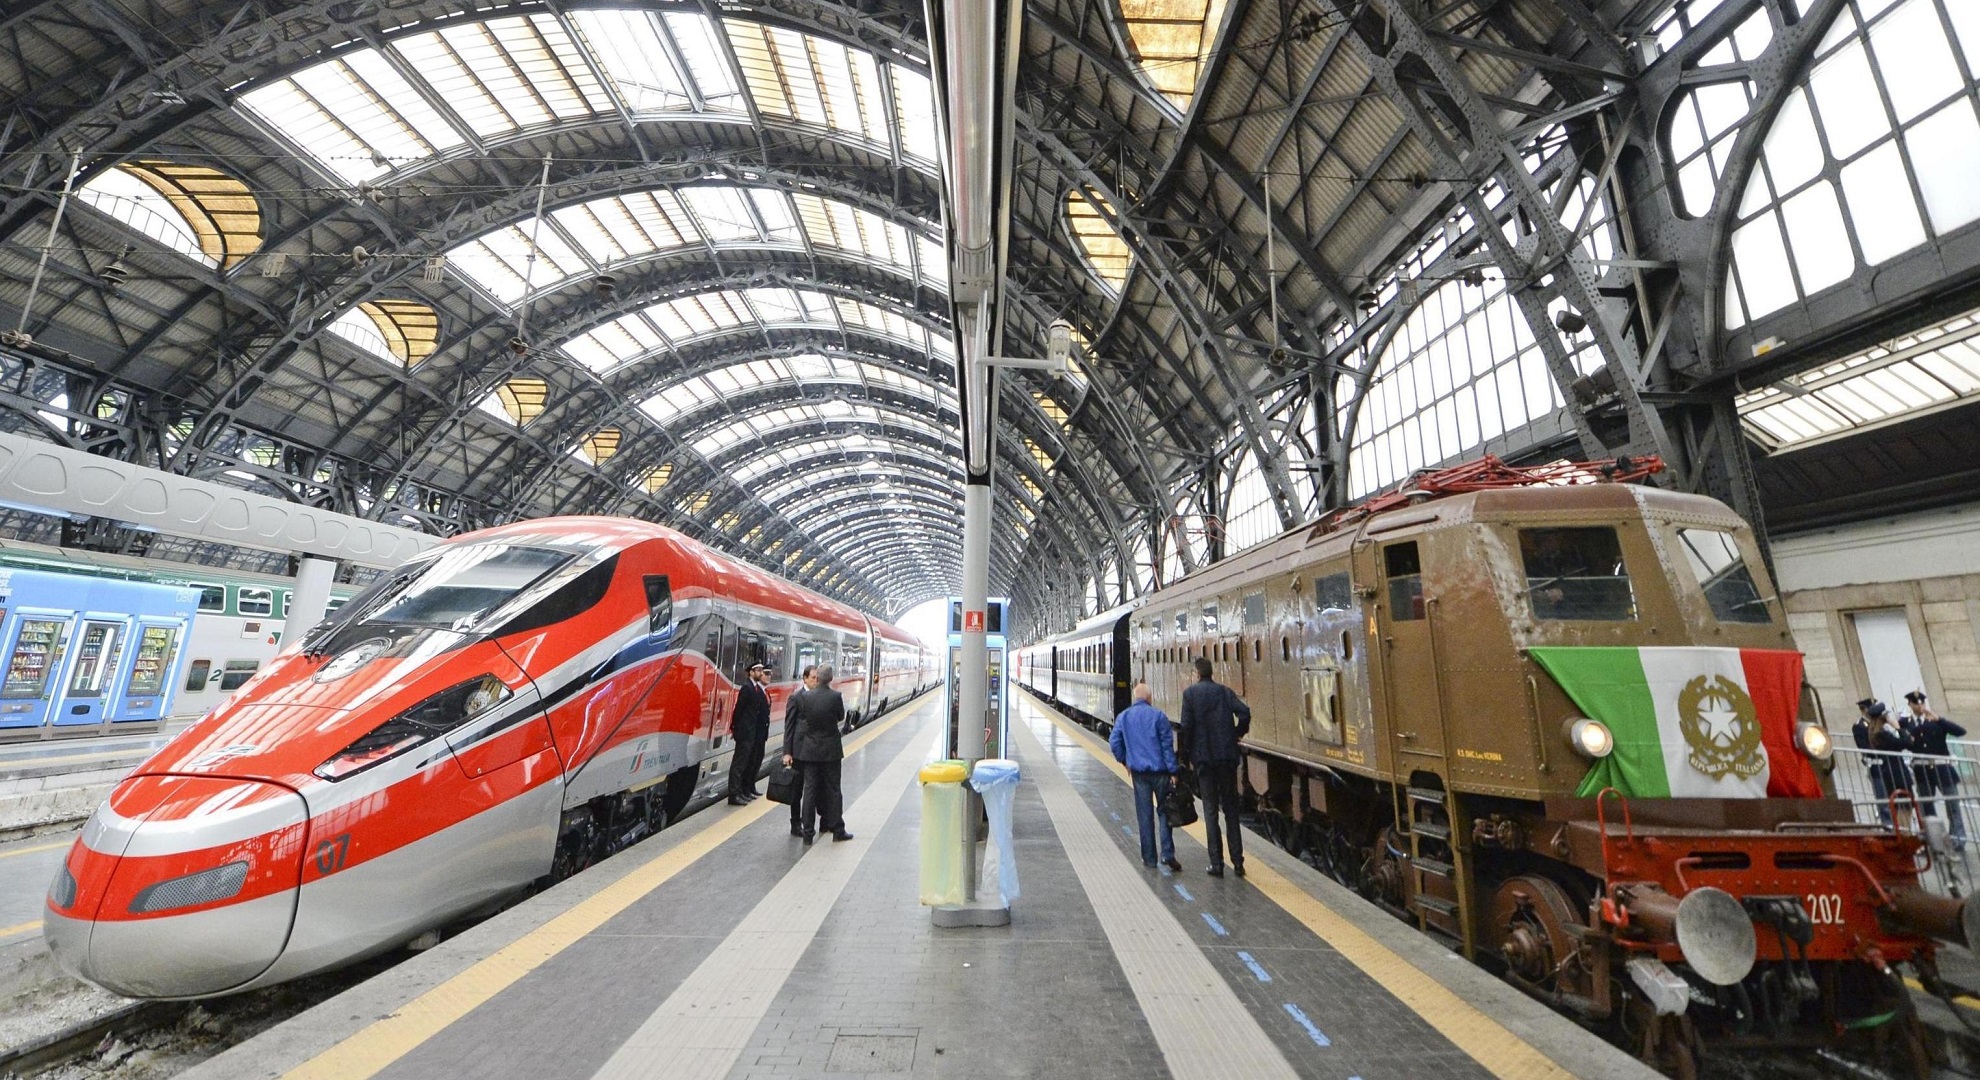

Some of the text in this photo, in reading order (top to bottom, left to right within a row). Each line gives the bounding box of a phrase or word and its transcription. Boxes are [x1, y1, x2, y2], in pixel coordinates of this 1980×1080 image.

[1369, 616, 1377, 635] A
[209, 669, 222, 681] 2
[317, 834, 351, 874] 07
[1807, 894, 1845, 924] 202
